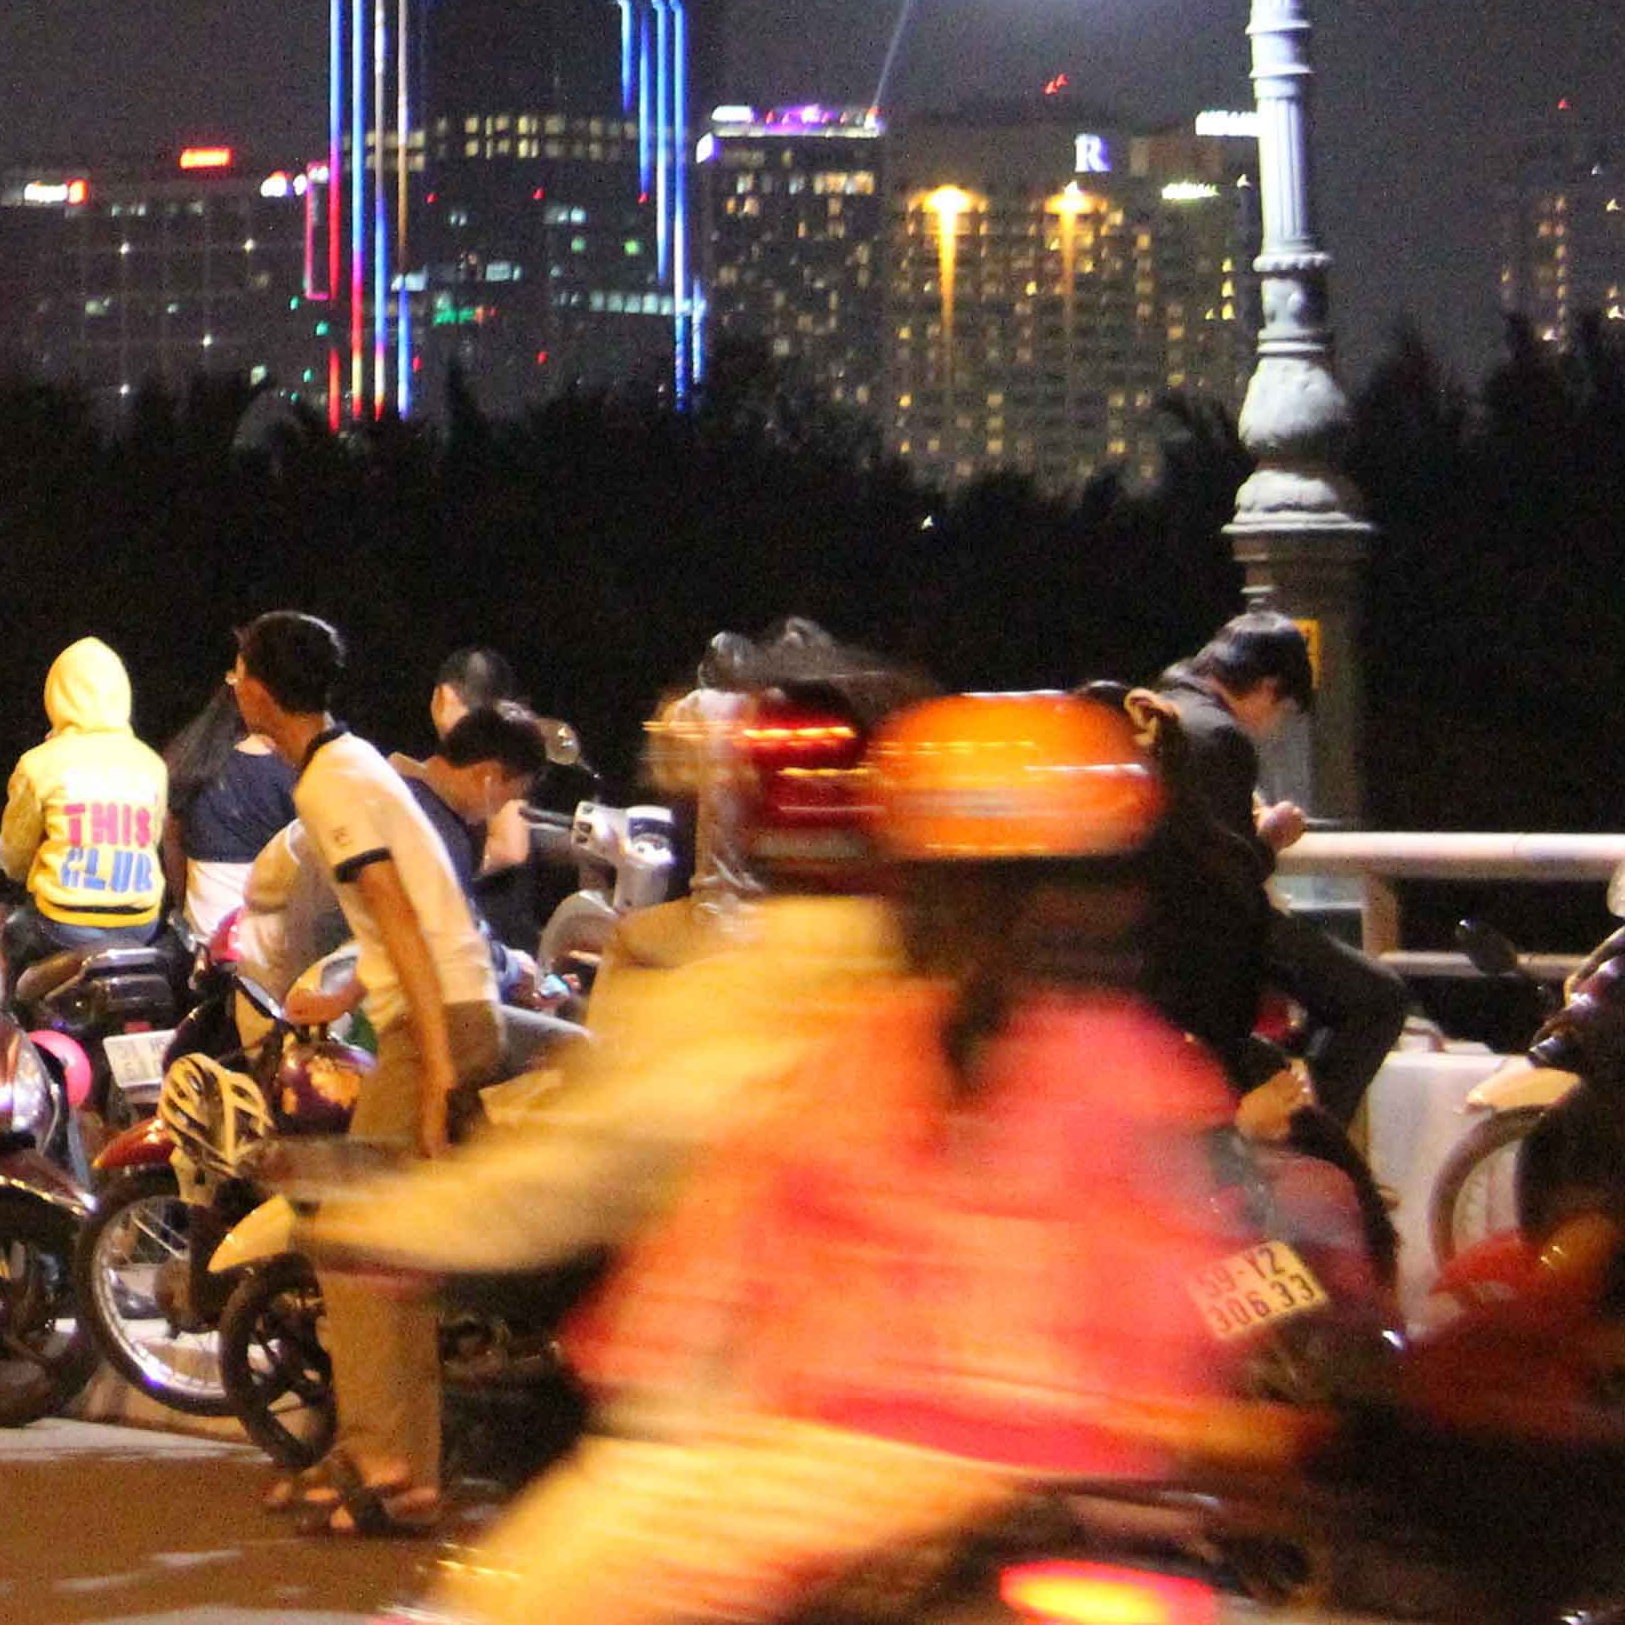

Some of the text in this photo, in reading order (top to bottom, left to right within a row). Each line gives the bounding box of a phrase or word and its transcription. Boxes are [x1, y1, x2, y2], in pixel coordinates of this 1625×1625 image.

[1075, 134, 1112, 173] R
[63, 802, 152, 849] THIS
[1196, 1246, 1286, 1298] 59-Y2
